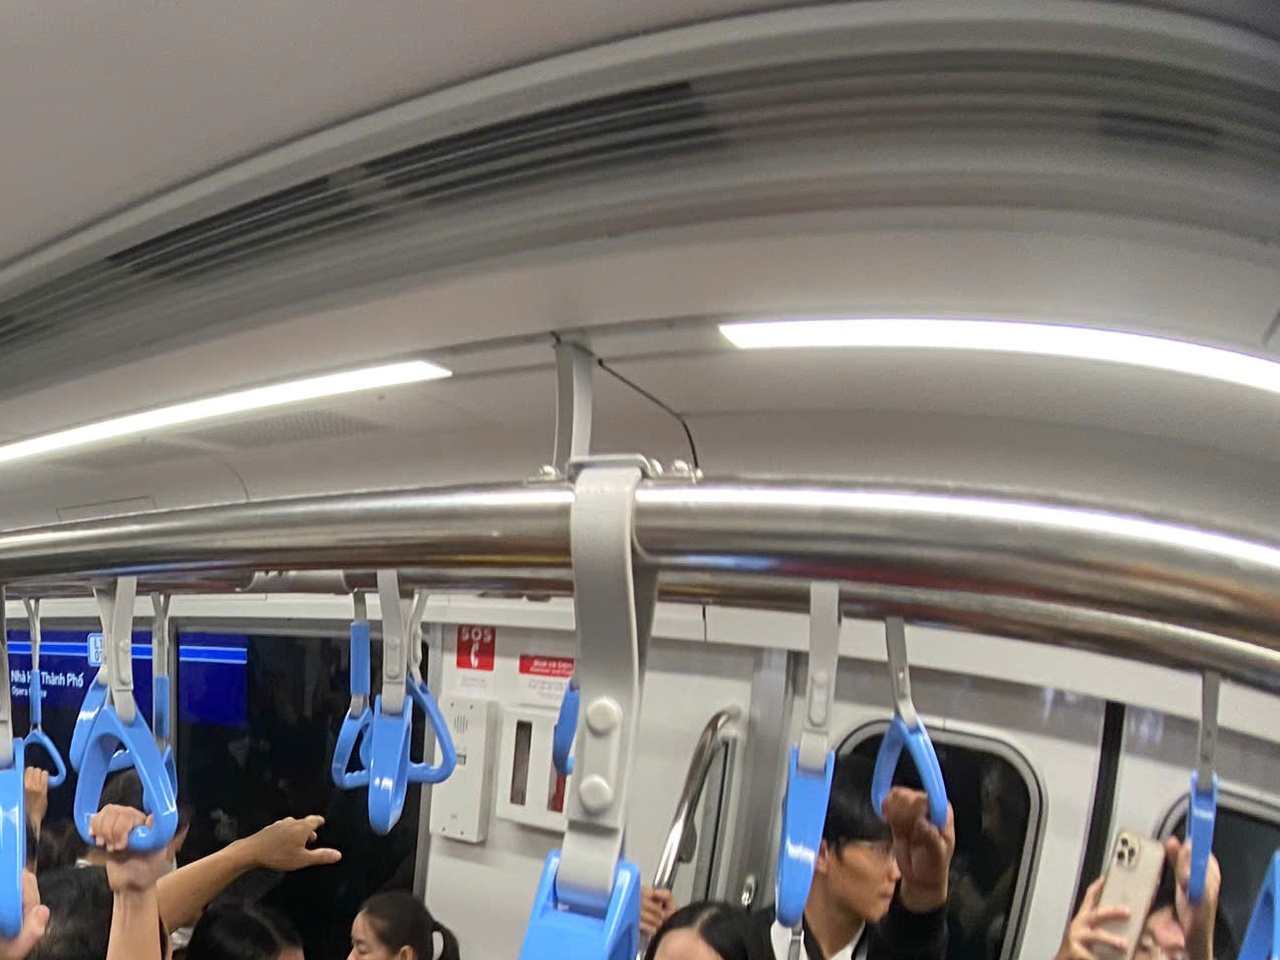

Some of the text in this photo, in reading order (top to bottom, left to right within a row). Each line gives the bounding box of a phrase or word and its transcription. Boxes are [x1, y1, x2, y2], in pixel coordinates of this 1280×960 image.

[461, 626, 492, 643] SOS
[41, 672, 65, 686] Thành
[66, 672, 84, 687] Phố
